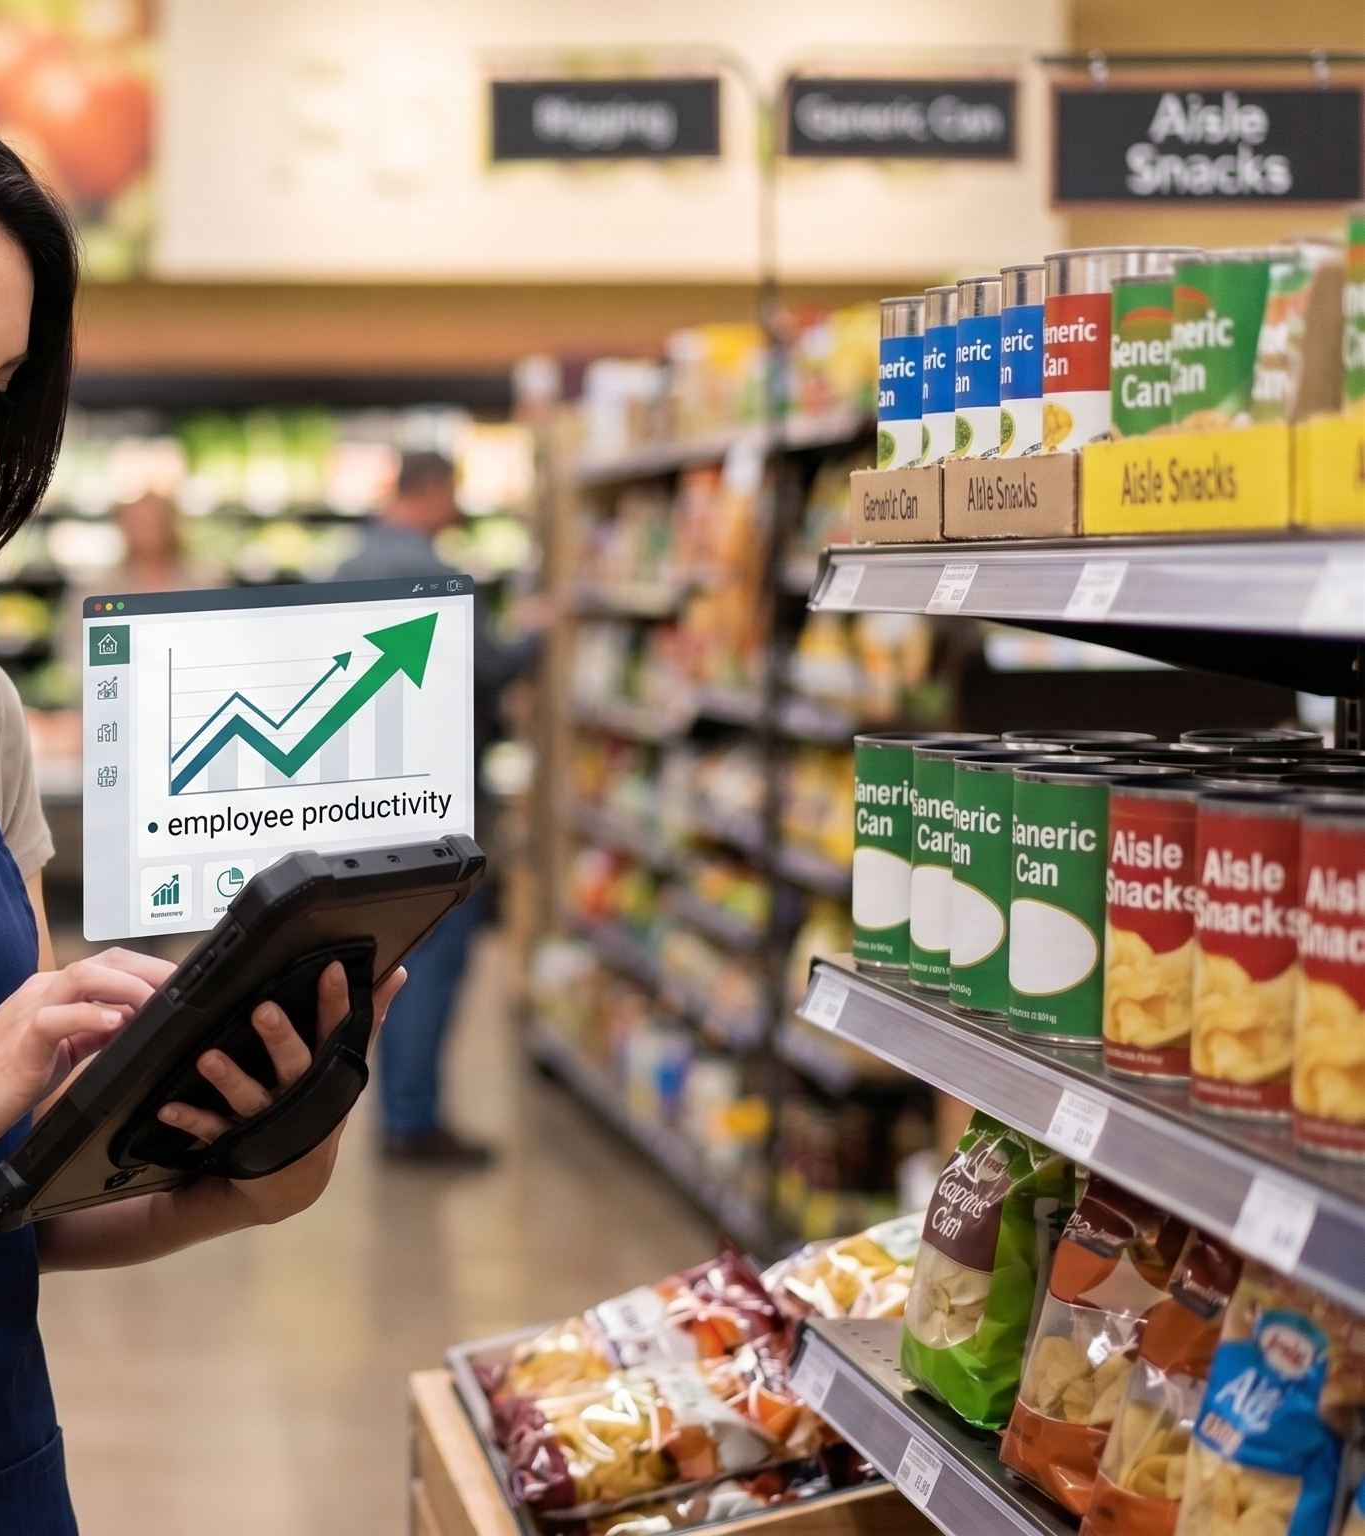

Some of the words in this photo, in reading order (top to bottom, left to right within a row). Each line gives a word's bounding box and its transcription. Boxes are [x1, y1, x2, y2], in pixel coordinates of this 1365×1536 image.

[1148, 91, 1269, 145] Aisle
[1125, 142, 1293, 195] Snacks
[956, 374, 970, 393] an
[1121, 374, 1172, 409] Can
[1171, 359, 1206, 396] an
[878, 390, 895, 408] an
[1122, 459, 1162, 505] Aisle
[1169, 451, 1237, 503] Snacks
[900, 488, 918, 520] Can
[168, 806, 294, 838] employee
[302, 791, 452, 831] productivity
[857, 808, 893, 837] Can
[1112, 830, 1183, 870] Aisle
[1016, 853, 1058, 886] Can
[1202, 848, 1285, 893] Aisle
[1106, 868, 1197, 914] Snacks
